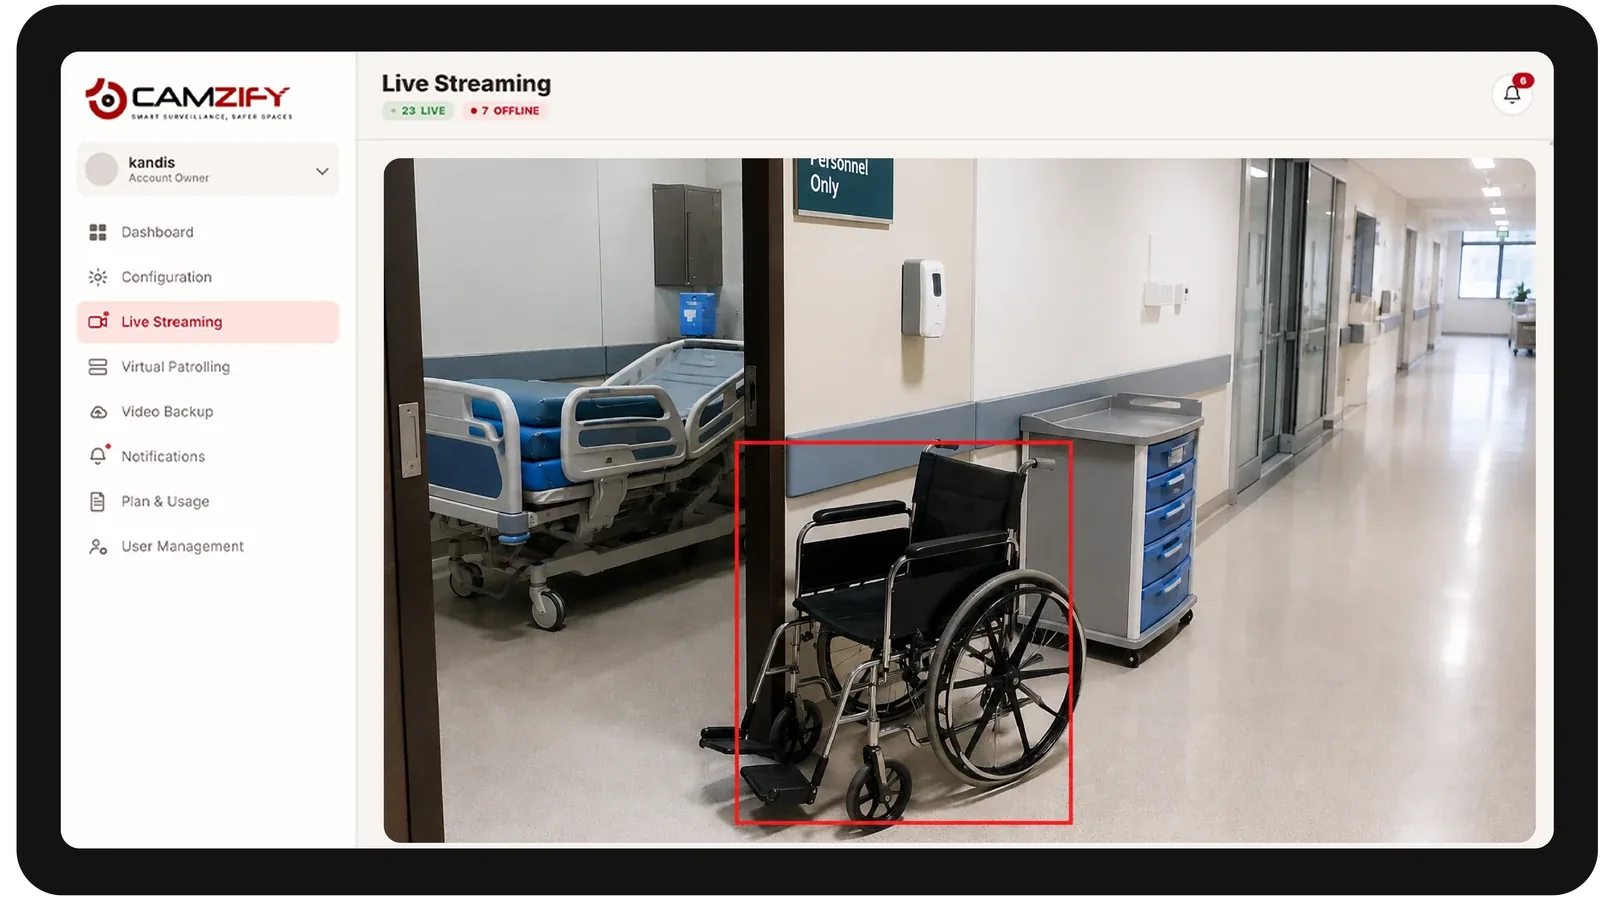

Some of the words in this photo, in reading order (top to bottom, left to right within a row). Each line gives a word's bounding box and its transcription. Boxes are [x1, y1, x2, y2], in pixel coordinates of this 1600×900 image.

[382, 73, 430, 92] Live
[434, 73, 552, 97] Streaming
[1519, 76, 1527, 85] 6
[132, 86, 291, 107] CAMZIFY
[163, 113, 228, 121] SURVEILLANCE,
[401, 106, 416, 115] 23
[421, 106, 446, 115] LIVE
[482, 106, 489, 115] 7
[494, 106, 540, 115] OFFLINE
[129, 156, 176, 168] kandis
[129, 173, 172, 182] Account
[175, 173, 209, 182] Owner
[810, 173, 840, 199] Only
[121, 225, 194, 238] Dashboard
[121, 271, 213, 285] Configuration
[121, 316, 149, 328] Live
[153, 316, 223, 331] Streaming
[121, 360, 165, 373] Virtual
[169, 360, 231, 376] Patrolling
[121, 405, 161, 418] Video
[164, 405, 214, 420] Backup
[121, 450, 206, 463] Notifications
[121, 495, 151, 508] Plan
[154, 495, 164, 508] &
[167, 495, 210, 510] Usage
[121, 540, 153, 553] User
[157, 540, 245, 555] Management
